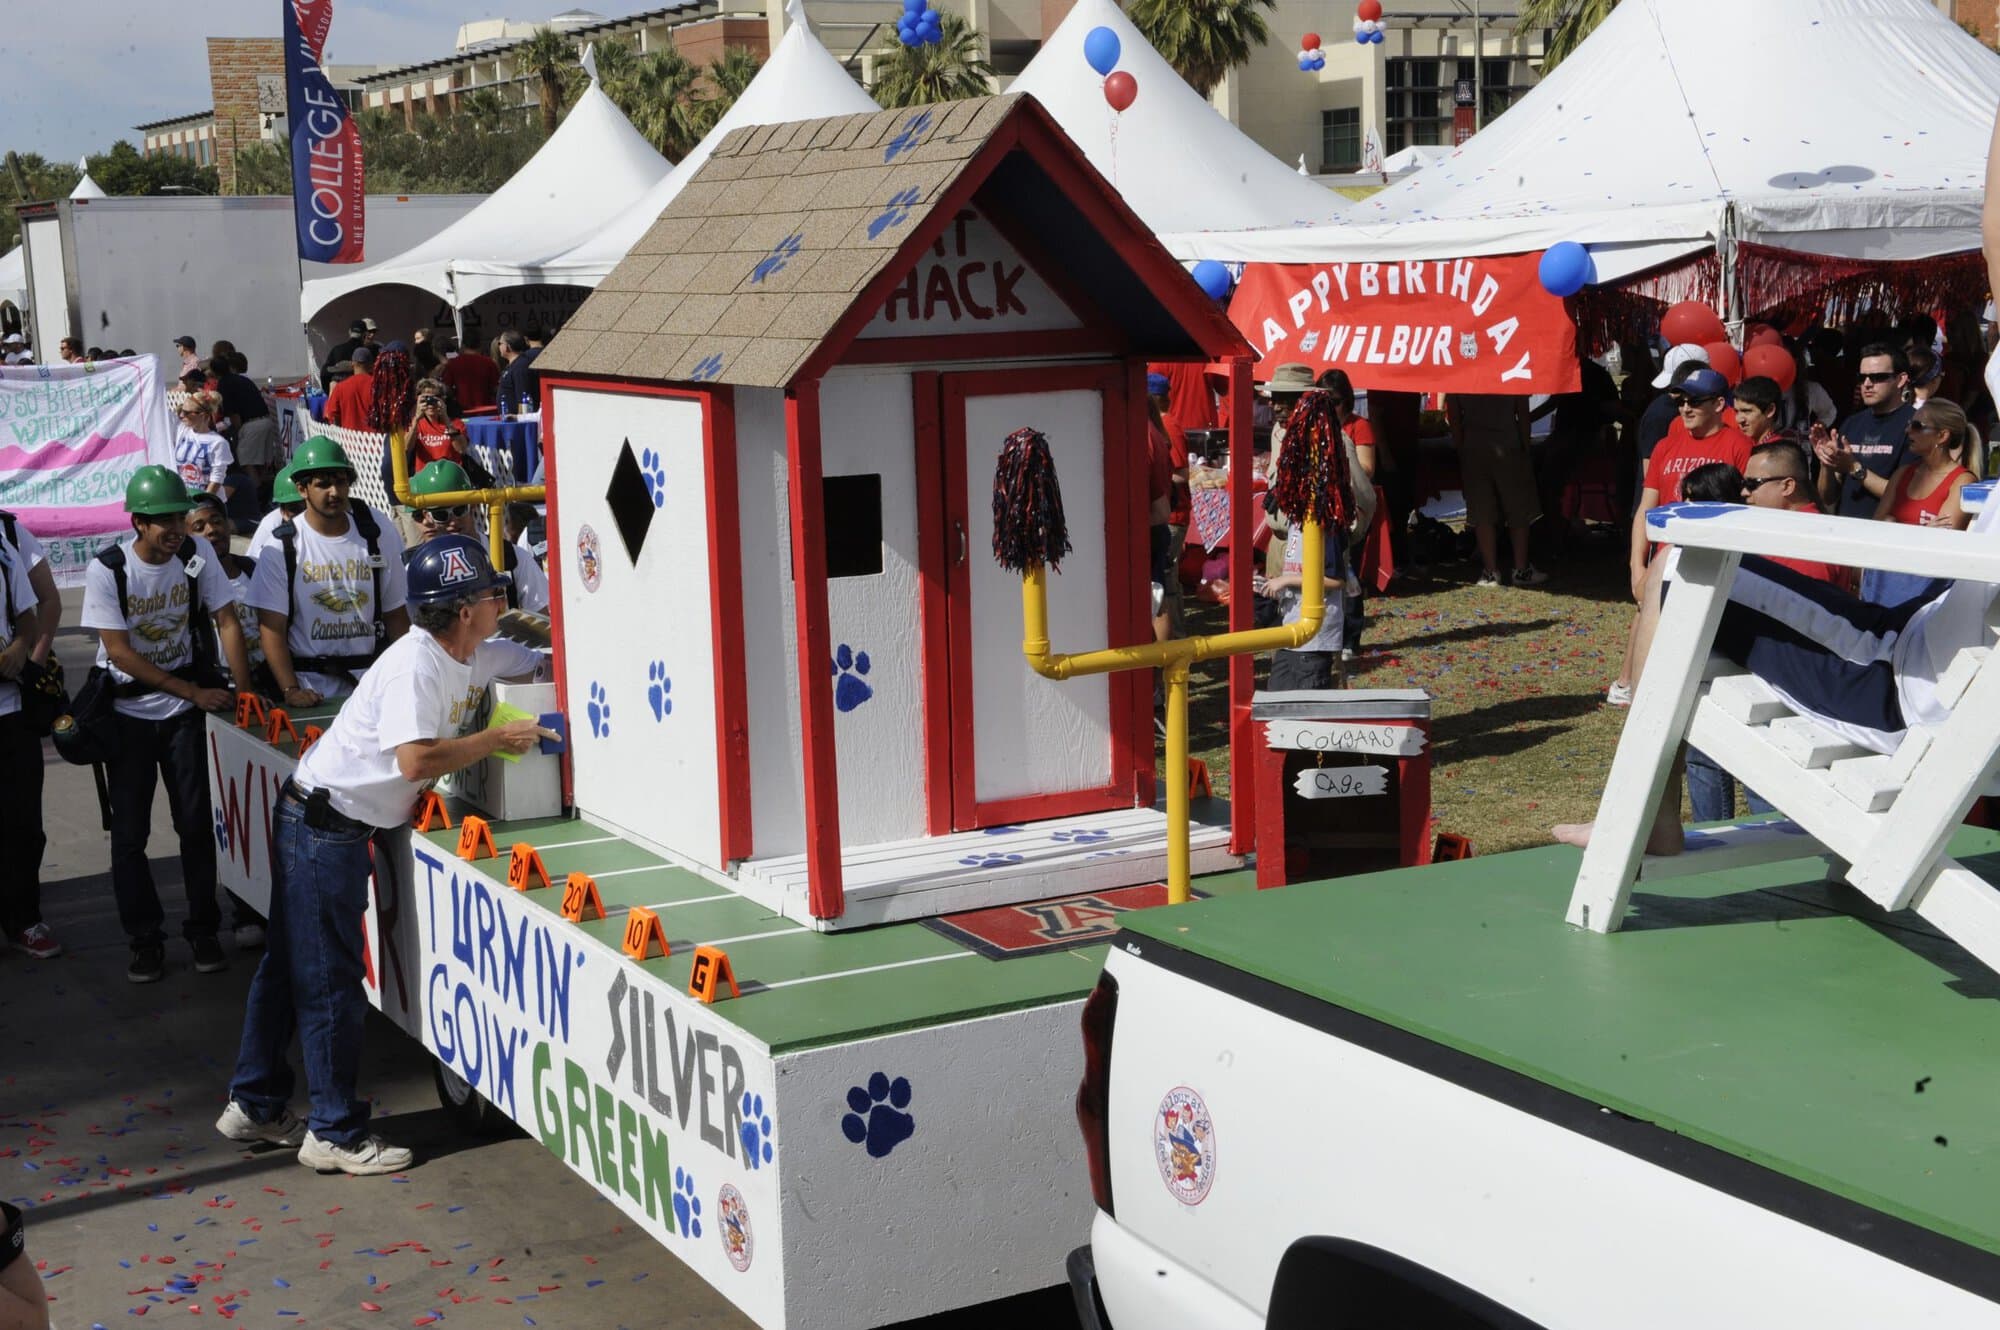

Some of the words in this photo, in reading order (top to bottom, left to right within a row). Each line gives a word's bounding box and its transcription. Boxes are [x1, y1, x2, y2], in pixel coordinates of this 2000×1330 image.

[303, 87, 343, 246] COLLEGE
[353, 152, 364, 219] UNIVERSITY
[353, 225, 364, 245] THE
[522, 288, 590, 304] UNIVER
[884, 260, 1028, 322] HACK
[1254, 262, 1349, 356] APPY
[1663, 457, 1724, 475] ARIZO
[303, 559, 343, 584] Santa
[440, 547, 478, 587] A
[461, 825, 474, 850] 40
[510, 851, 523, 883] 30
[563, 882, 582, 914] 20
[627, 918, 643, 951] 10
[691, 954, 710, 994] G
[414, 847, 586, 1043] TURNIN'
[605, 968, 752, 1170] SILVER
[428, 963, 529, 1123] GOIN'
[532, 1040, 677, 1235] GREEN
